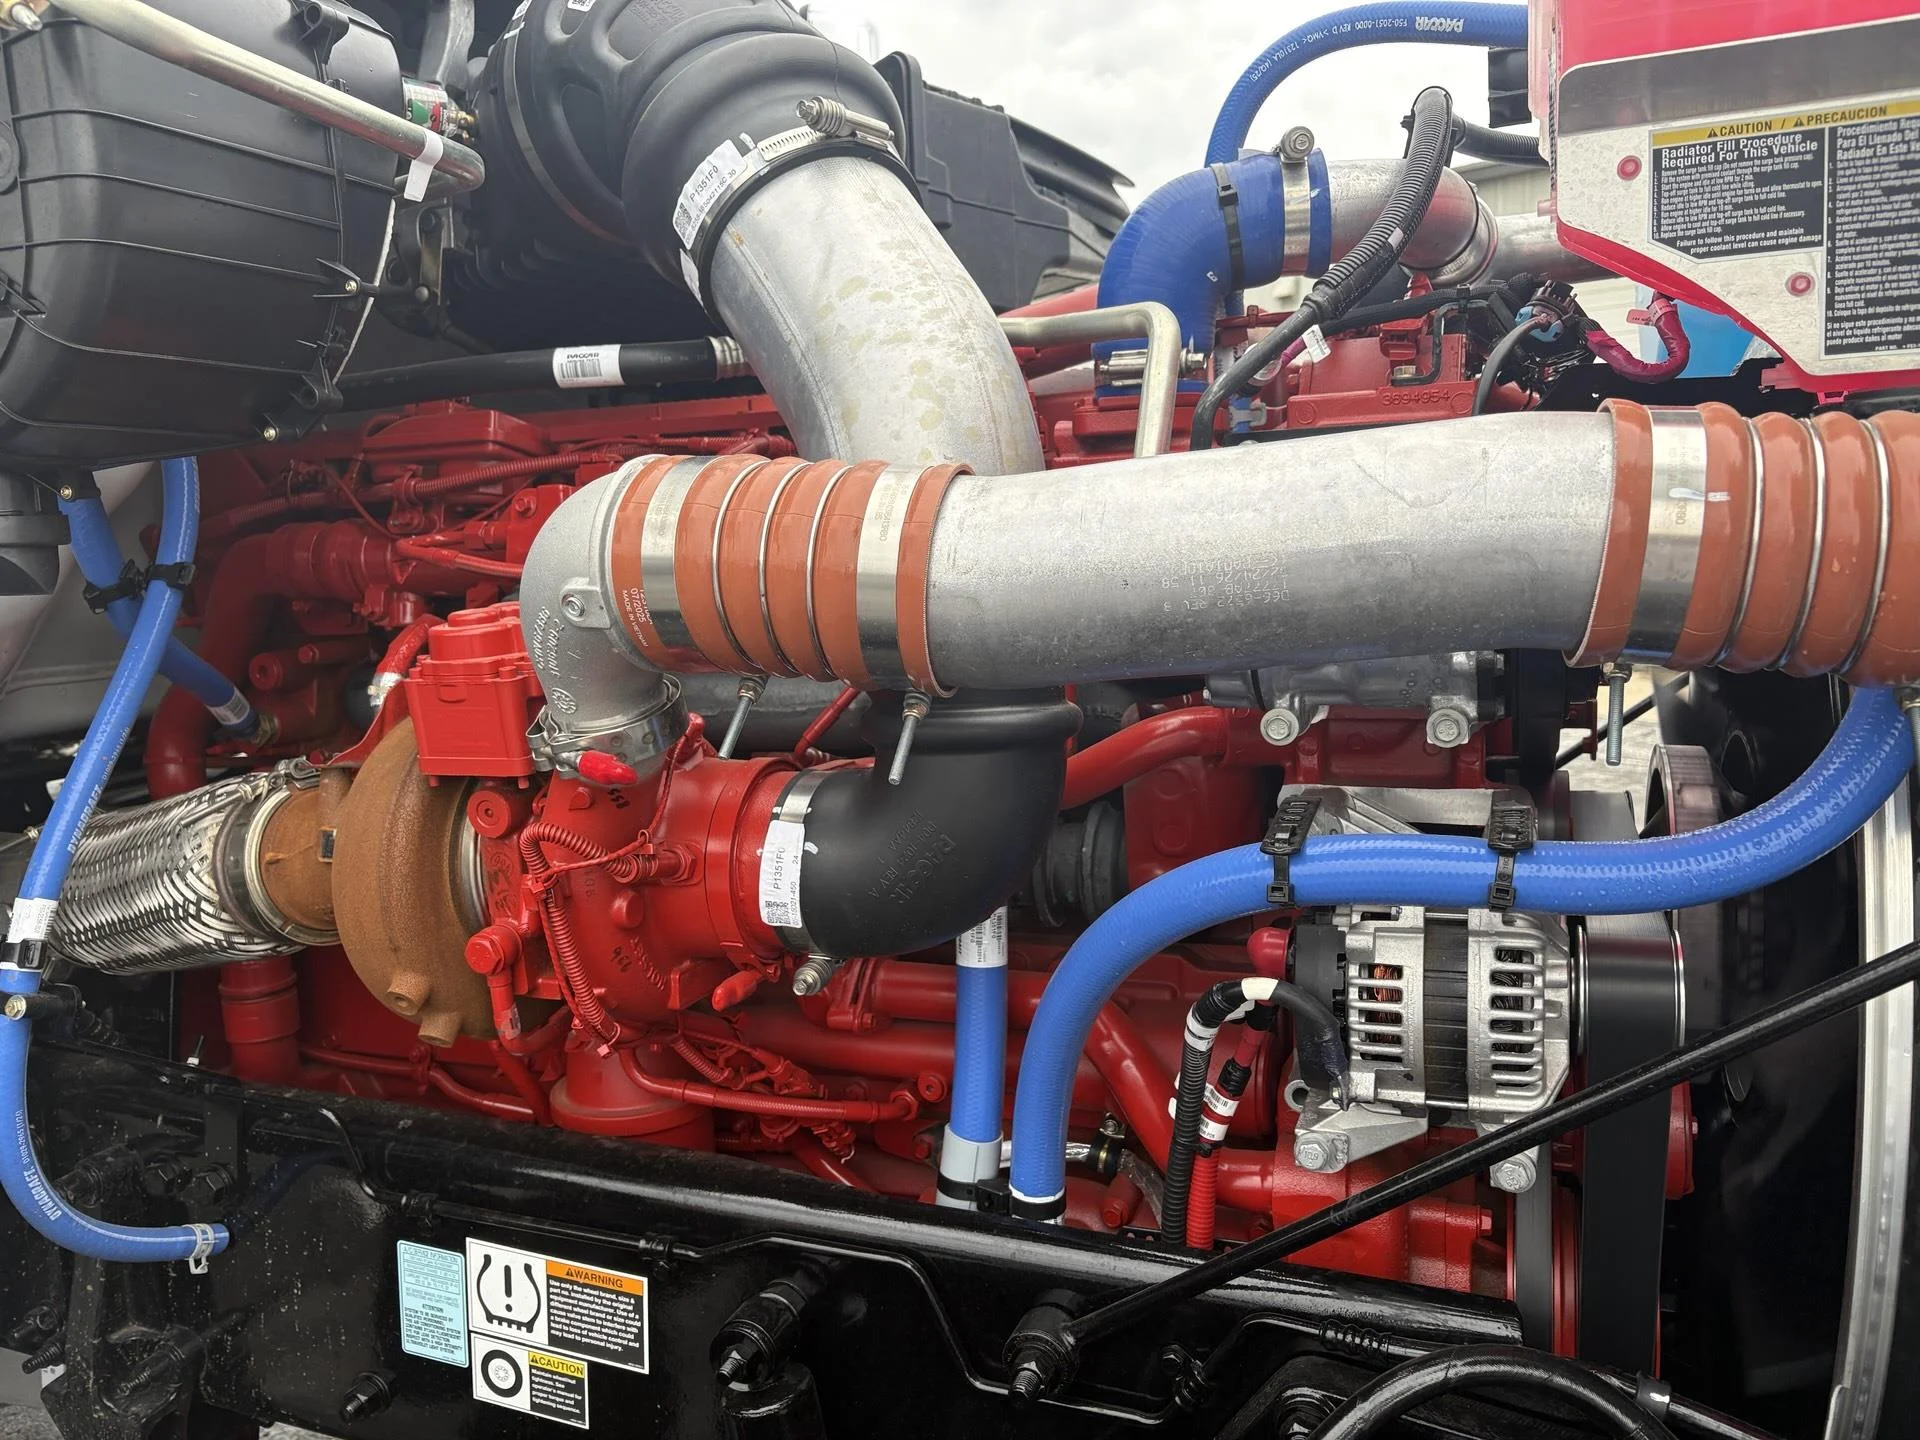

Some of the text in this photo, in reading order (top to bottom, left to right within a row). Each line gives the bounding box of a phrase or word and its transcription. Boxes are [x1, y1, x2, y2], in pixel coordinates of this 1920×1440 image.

[1416, 16, 1464, 32] PACCAR
[1720, 121, 1773, 137] CAUTION
[1807, 105, 1888, 126] PRECAUCION
[1662, 132, 1801, 158] Radiator Fill Procedure
[1662, 140, 1817, 168] Required For This Vehicle
[690, 165, 718, 202] P1351F0
[1676, 238, 1695, 246] Failure
[1736, 231, 1764, 241] procedure
[1778, 227, 1803, 235] maintain
[1690, 246, 1708, 254] proper
[1778, 235, 1797, 245] engine
[1798, 233, 1821, 243] damage
[622, 590, 632, 613] MADE
[630, 588, 646, 622] 07/2025
[574, 1269, 623, 1288] WARNING
[549, 1300, 572, 1310] different
[600, 1291, 617, 1300] brand,
[570, 1320, 600, 1332] component
[581, 1336, 605, 1347] personal
[606, 1342, 623, 1351] injury.
[588, 1331, 607, 1339] vehicle
[608, 1336, 627, 1344] control
[539, 1356, 582, 1374] CAUTION
